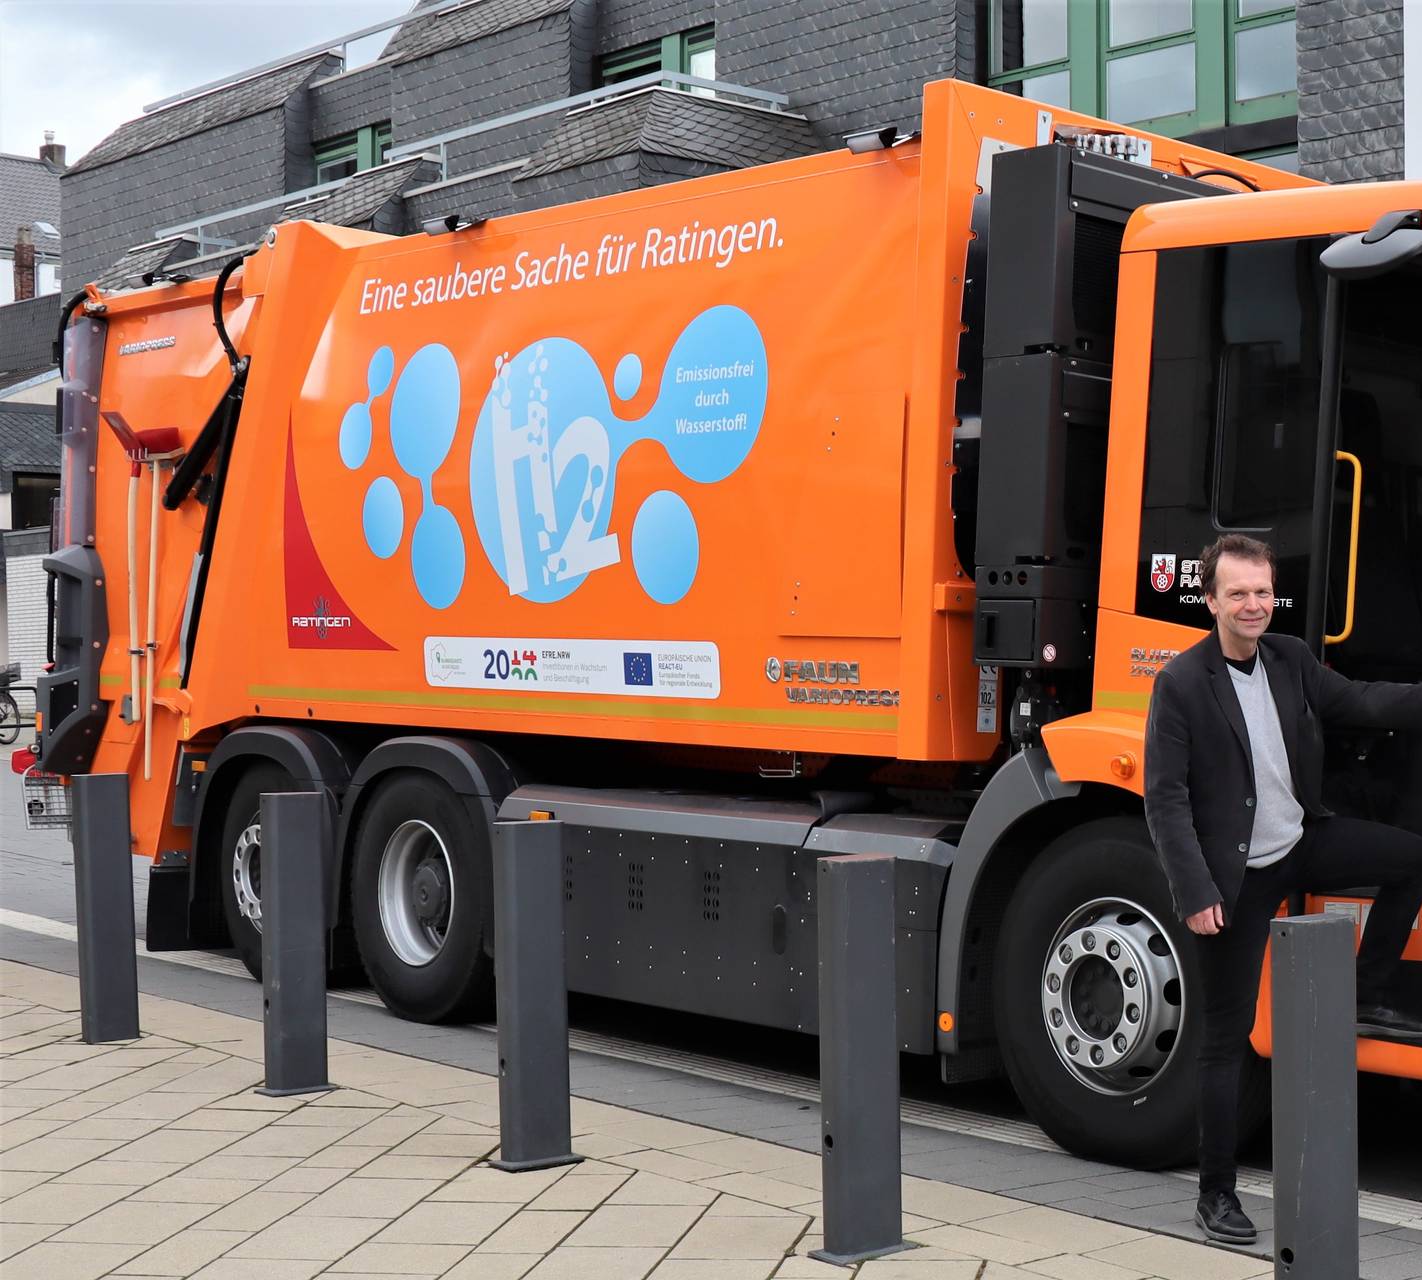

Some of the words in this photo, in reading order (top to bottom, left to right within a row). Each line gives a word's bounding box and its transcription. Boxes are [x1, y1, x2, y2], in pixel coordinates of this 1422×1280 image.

[359, 277, 408, 315] Eine
[411, 261, 507, 308] saubere
[510, 243, 590, 291] Sache
[595, 234, 638, 279] für
[640, 216, 785, 269] Ratingen.
[675, 360, 755, 384] Emissionsfrei
[694, 388, 730, 408] durch
[674, 412, 748, 436] Wasserstoff!
[482, 648, 510, 680] 20
[541, 650, 571, 660] EFRE.NRW
[783, 659, 860, 684] FAUN
